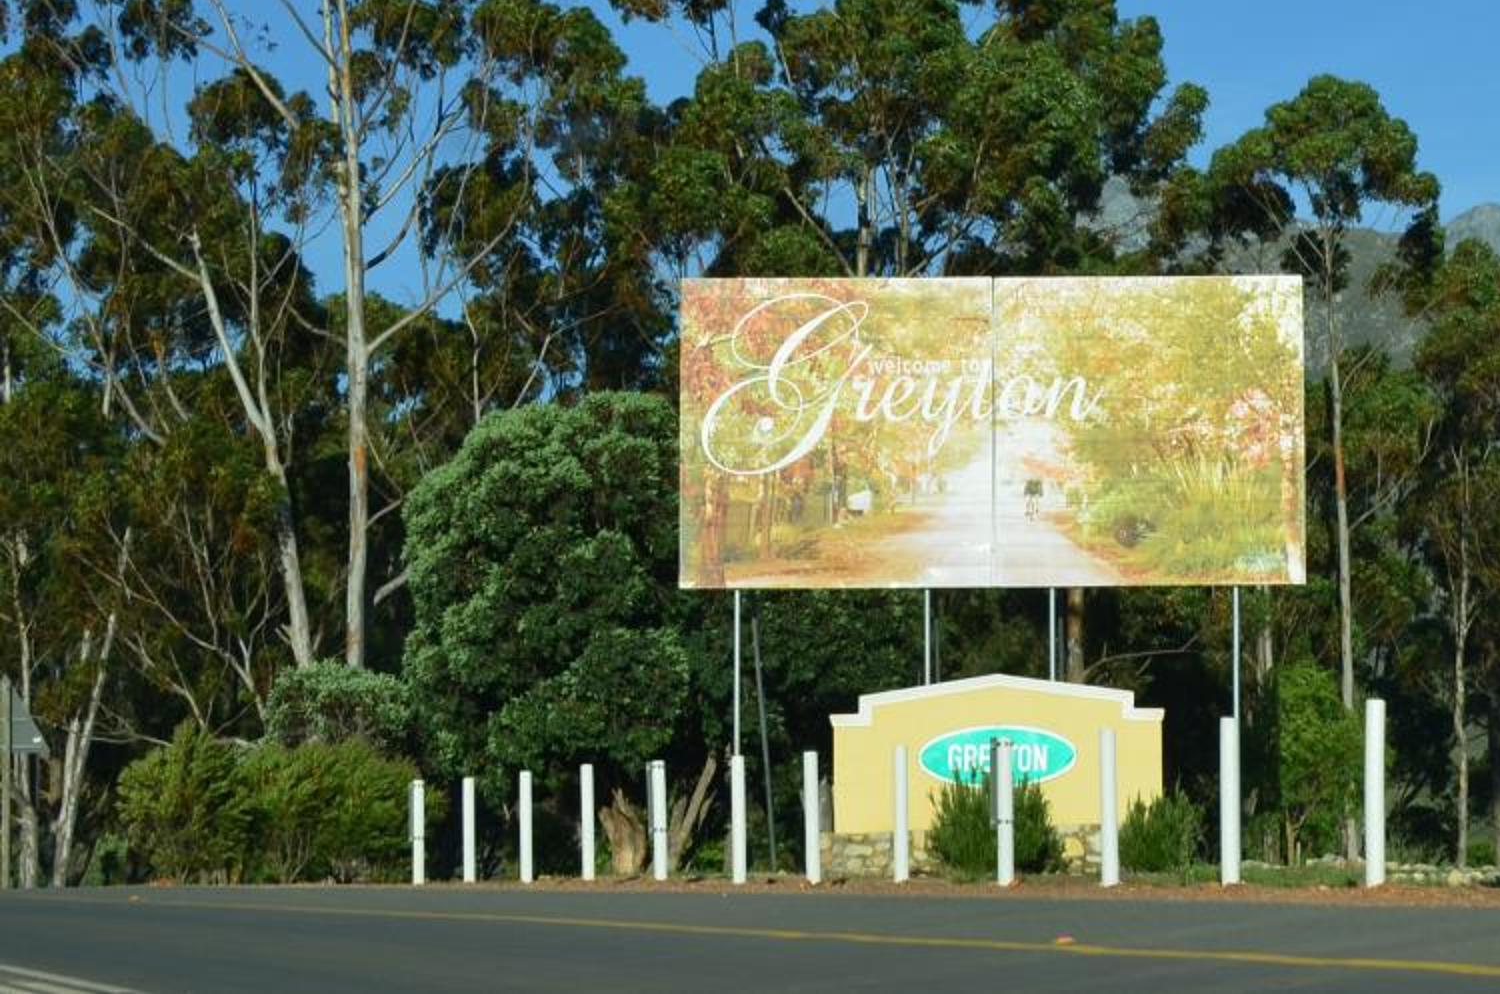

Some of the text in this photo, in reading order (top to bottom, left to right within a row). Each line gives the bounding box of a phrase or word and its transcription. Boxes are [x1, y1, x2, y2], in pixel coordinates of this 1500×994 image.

[871, 357, 950, 374] welcome
[702, 293, 1101, 475] Greyton
[948, 744, 1048, 773] GREON
